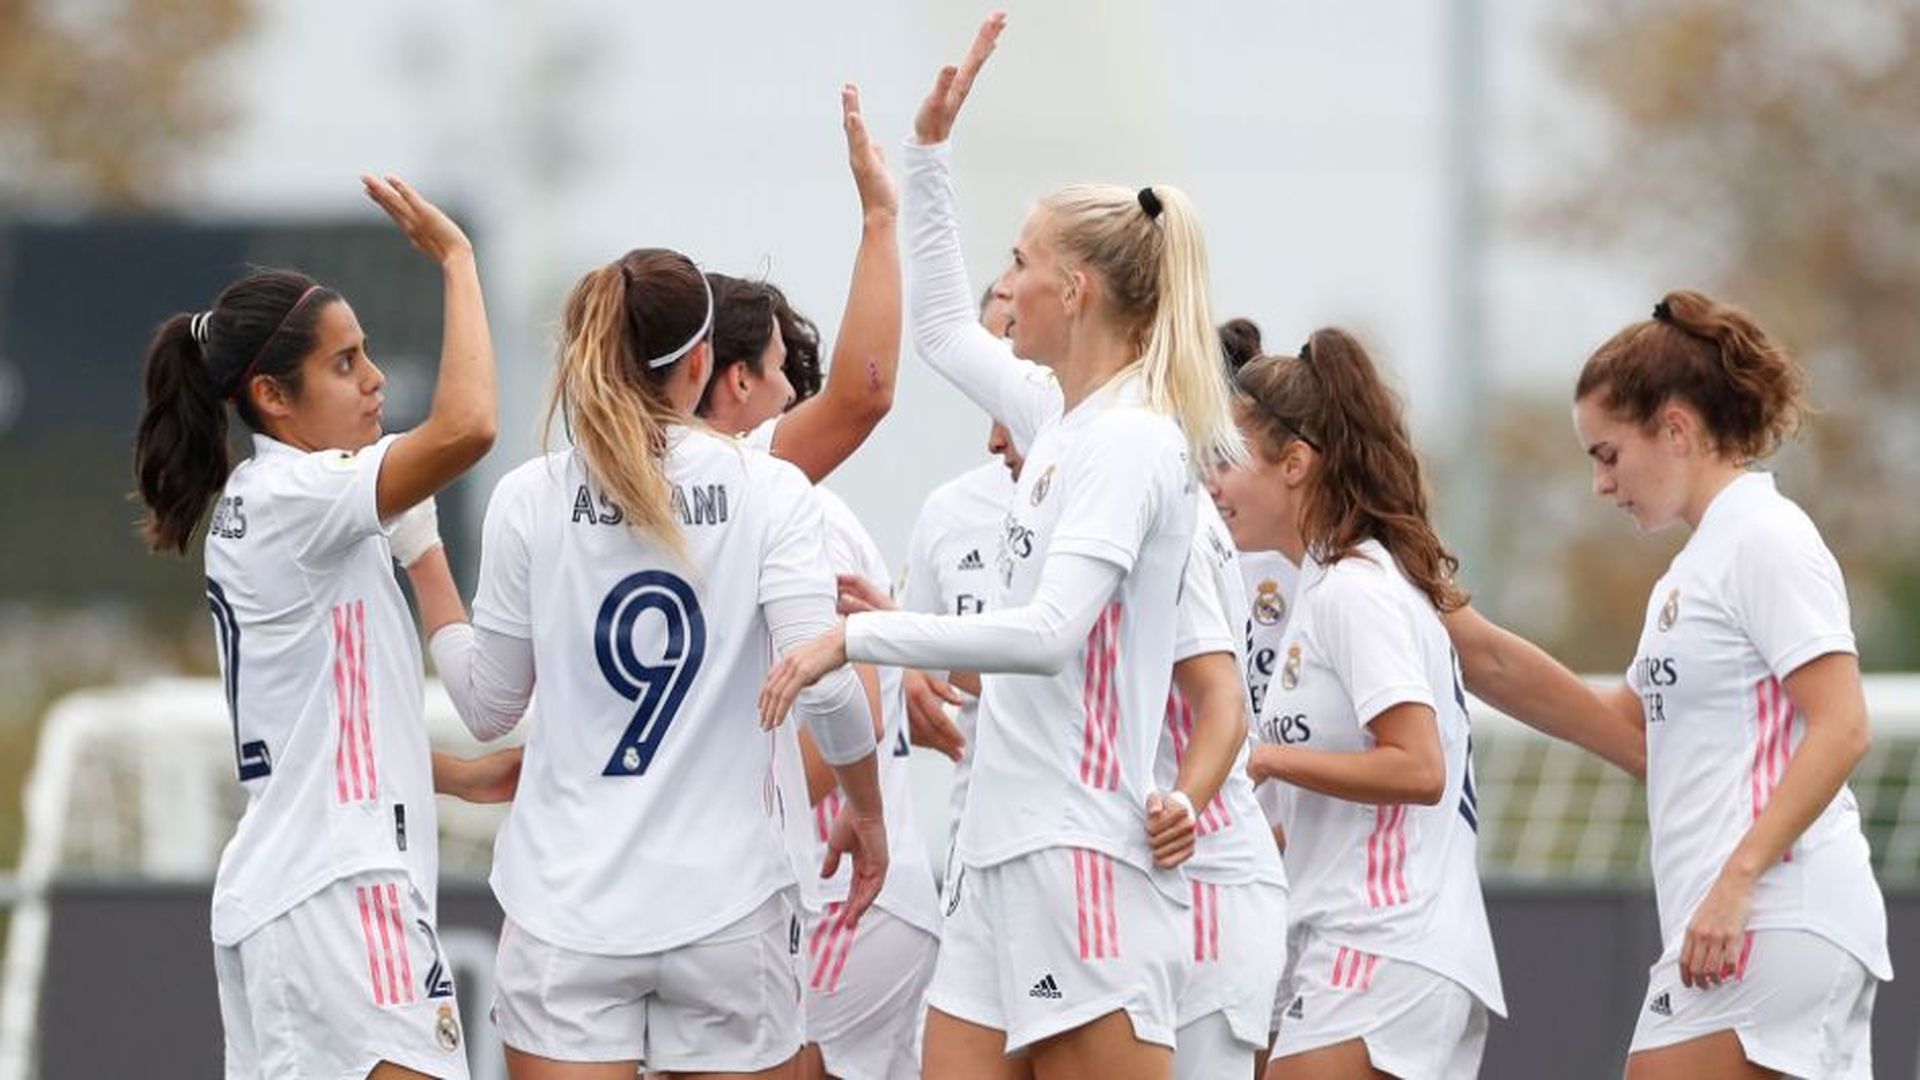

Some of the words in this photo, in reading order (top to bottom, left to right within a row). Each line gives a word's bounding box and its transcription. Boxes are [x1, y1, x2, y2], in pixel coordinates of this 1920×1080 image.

[572, 484, 728, 526] ASANI
[594, 569, 707, 776] 9
[416, 917, 453, 999] 2
